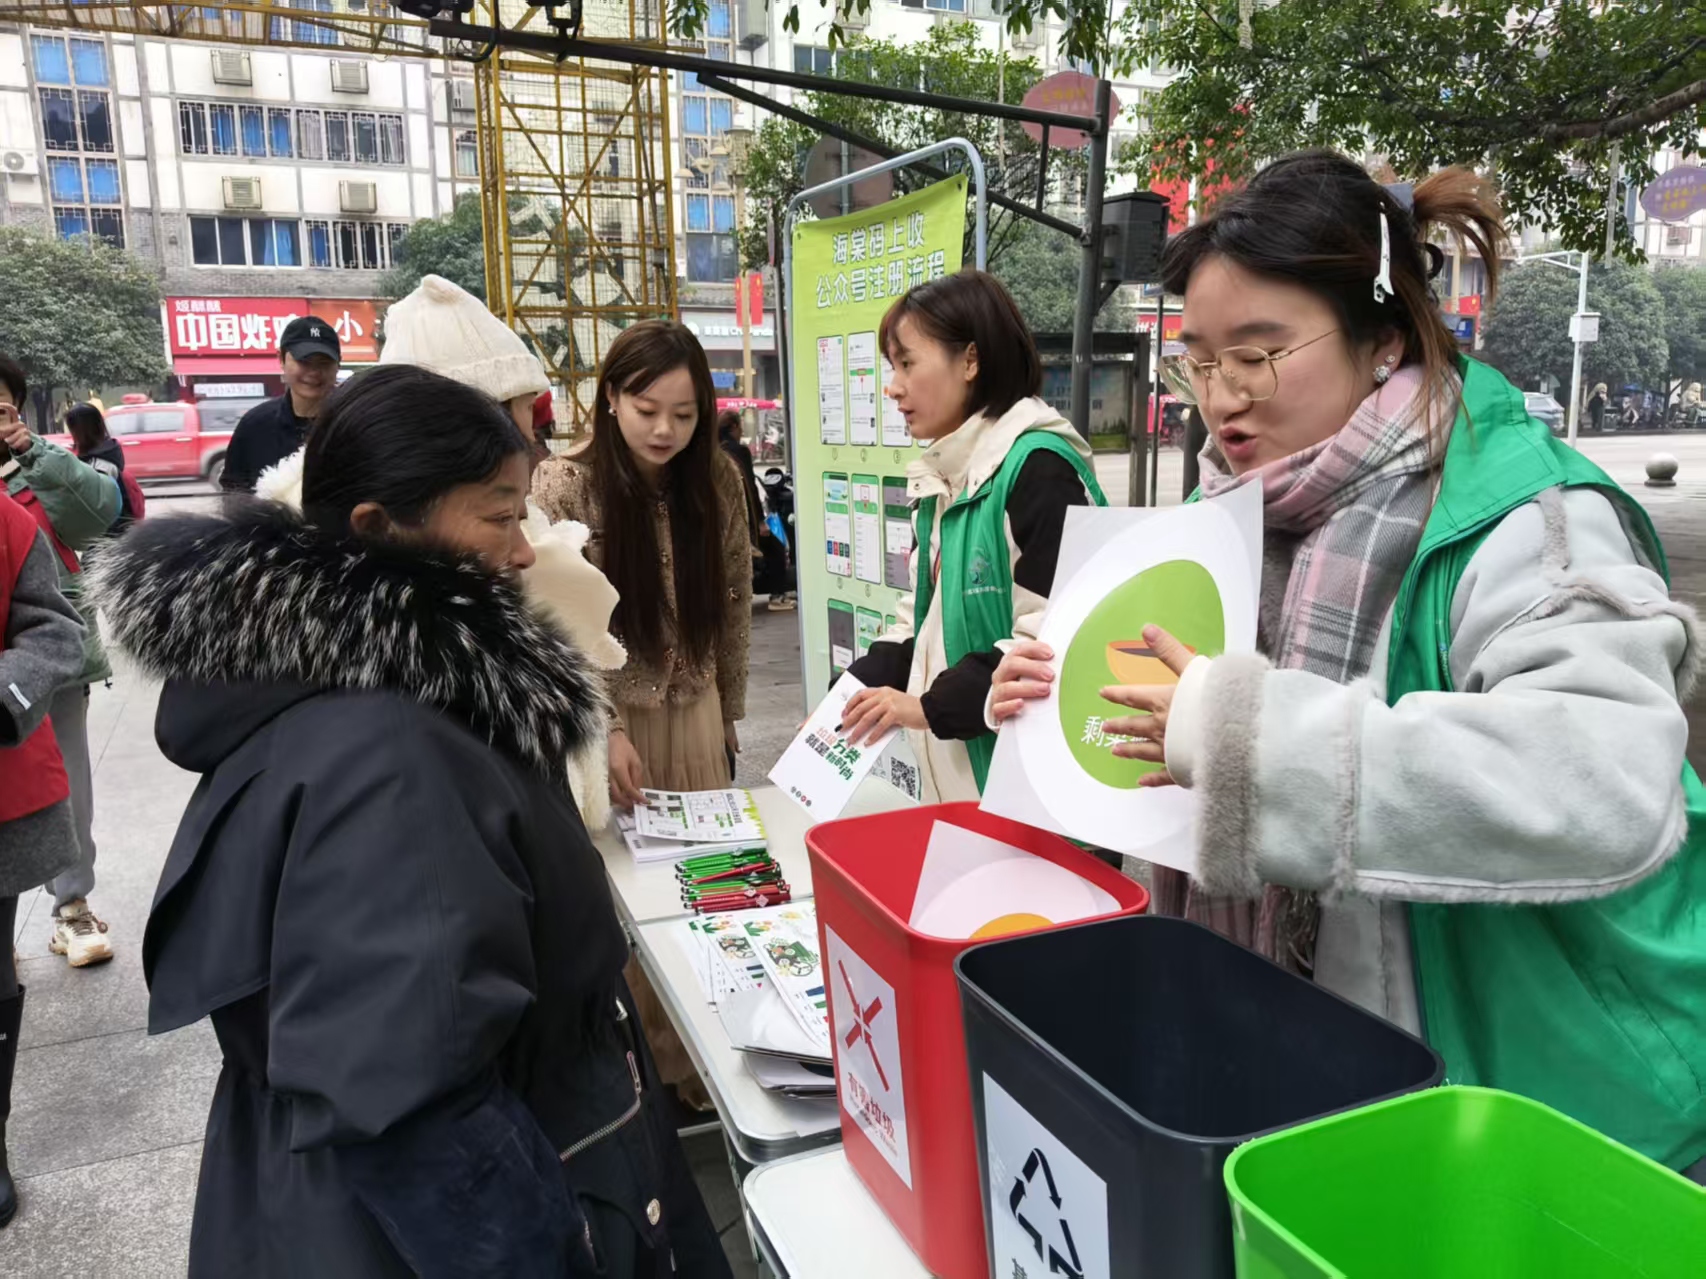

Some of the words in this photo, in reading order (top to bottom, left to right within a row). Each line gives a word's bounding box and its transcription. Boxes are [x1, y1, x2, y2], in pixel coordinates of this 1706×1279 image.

[832, 211, 926, 265] 海棠码上收
[816, 248, 946, 309] 公众号注册流程
[804, 732, 855, 781] 就是新时尚
